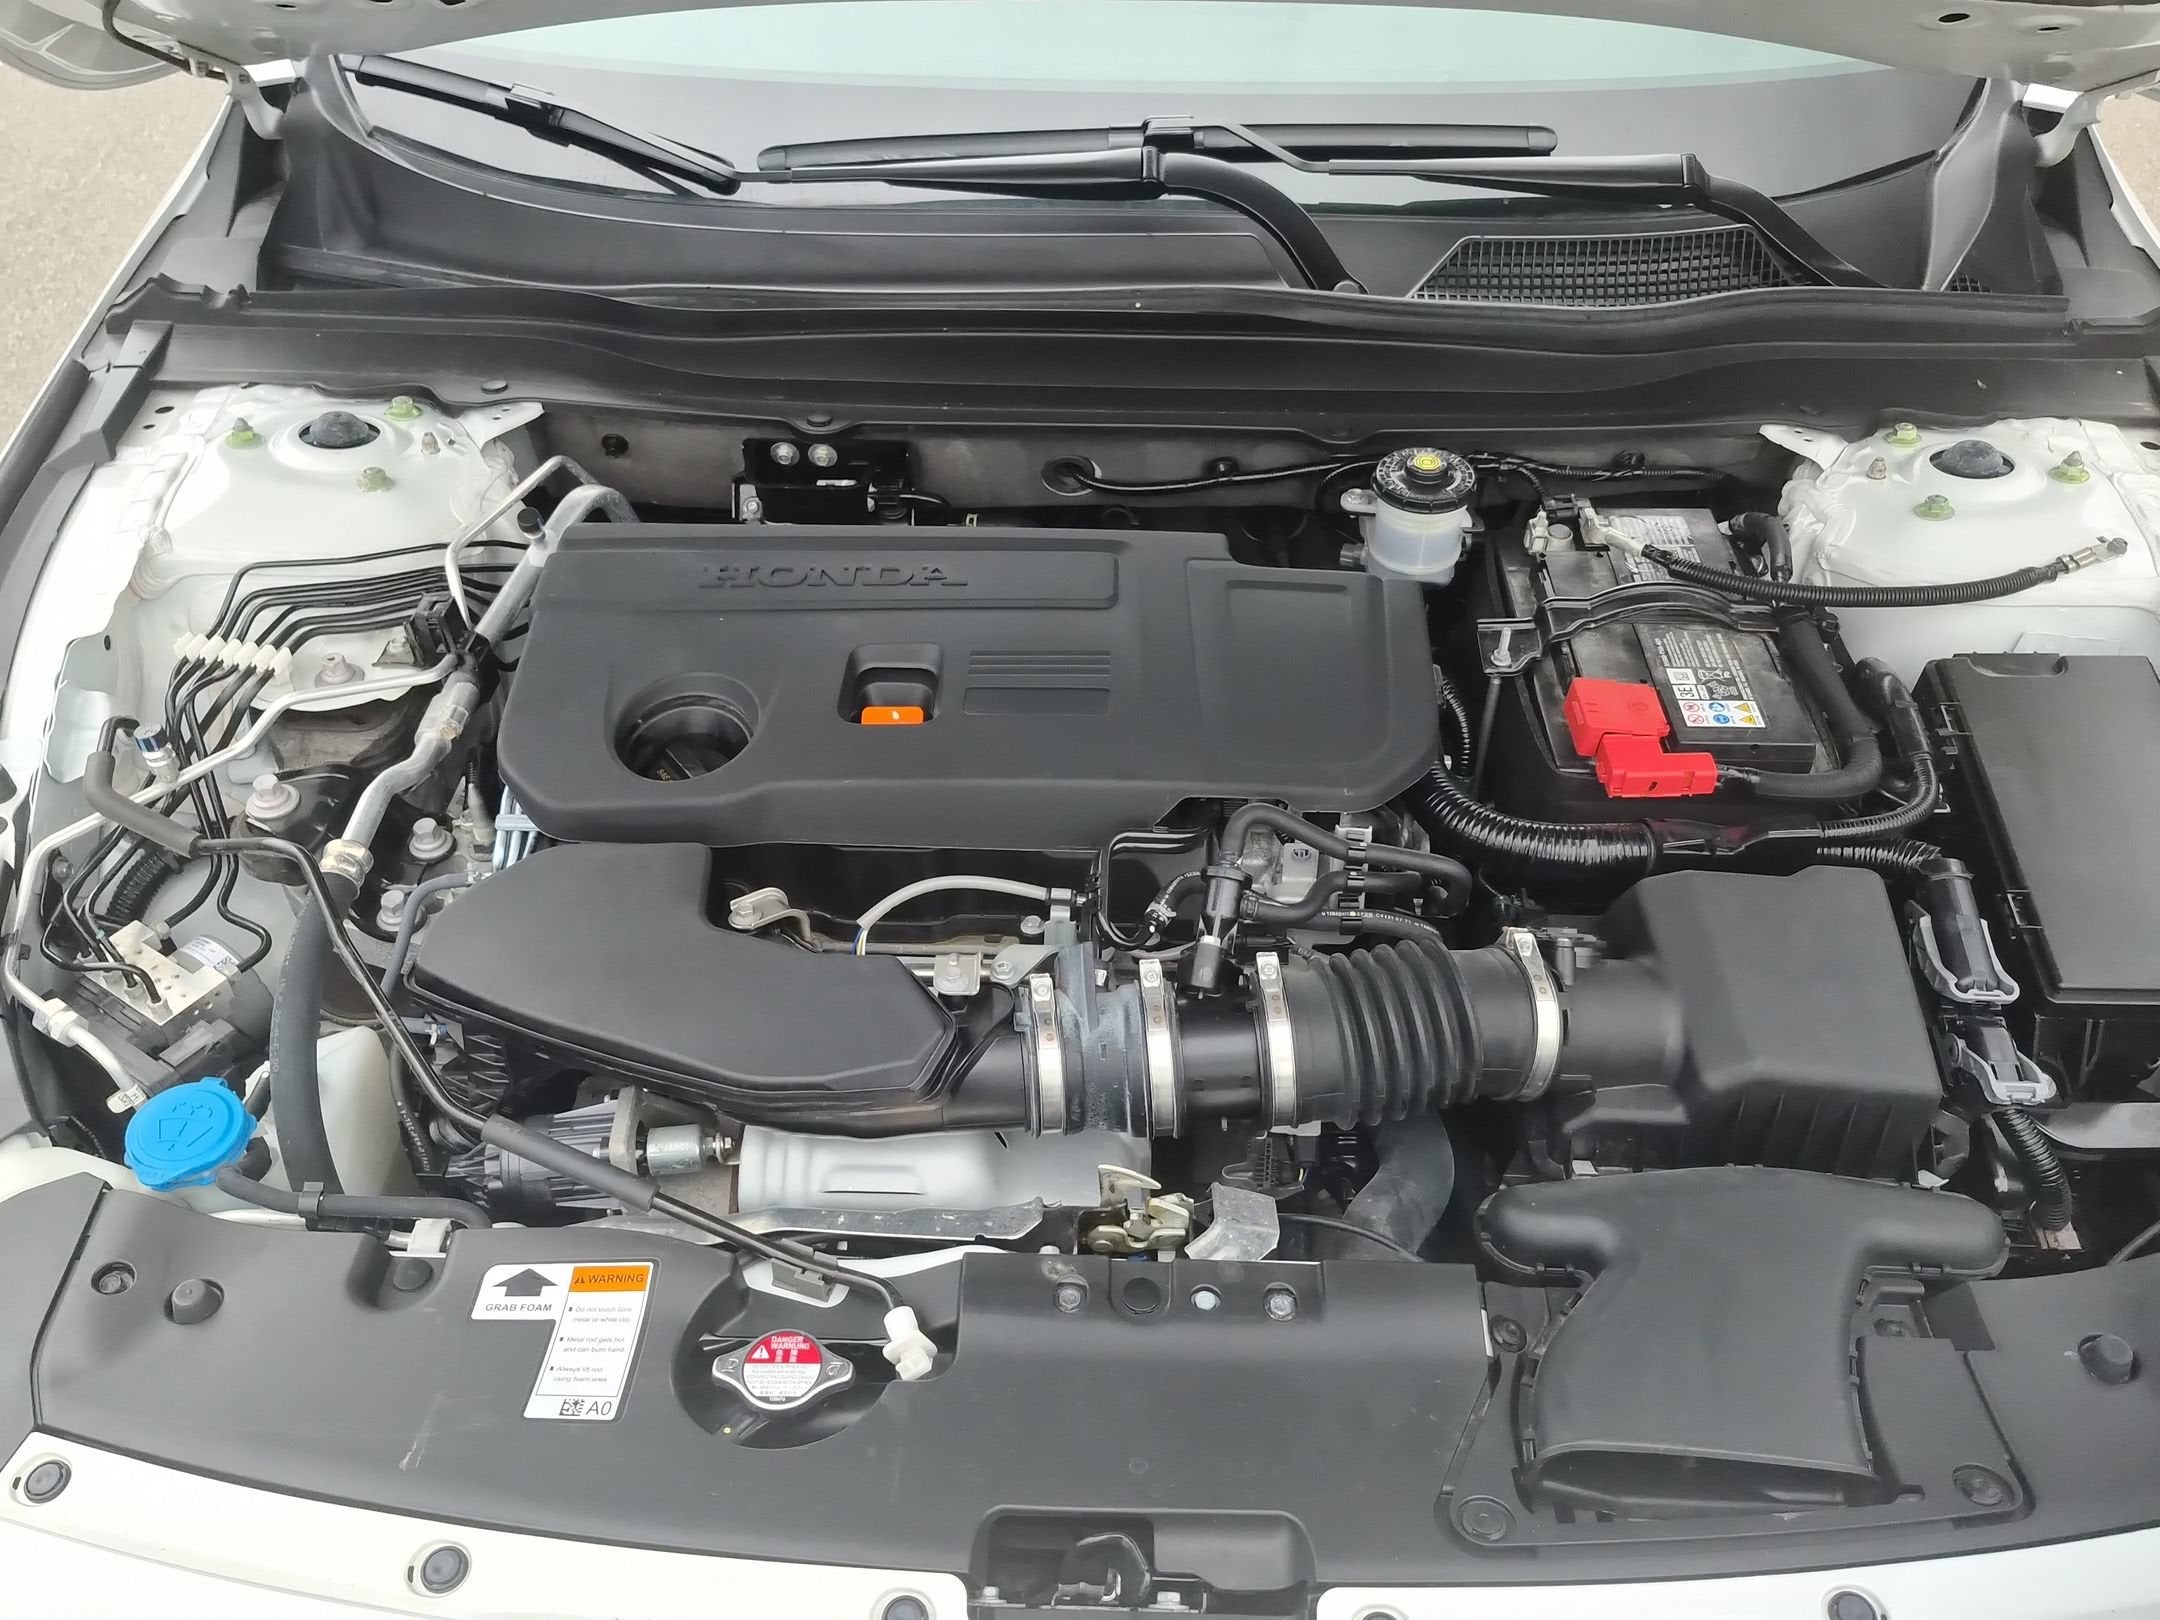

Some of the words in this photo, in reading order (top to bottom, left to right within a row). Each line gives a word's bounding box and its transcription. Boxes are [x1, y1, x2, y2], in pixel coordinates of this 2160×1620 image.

[699, 565, 968, 588] HONDA
[1677, 686, 1695, 698] 3E
[588, 1274, 644, 1283] WARNING
[485, 1303, 517, 1311] GRAB
[520, 1303, 552, 1311] FOAM
[585, 1400, 612, 1416] A0
